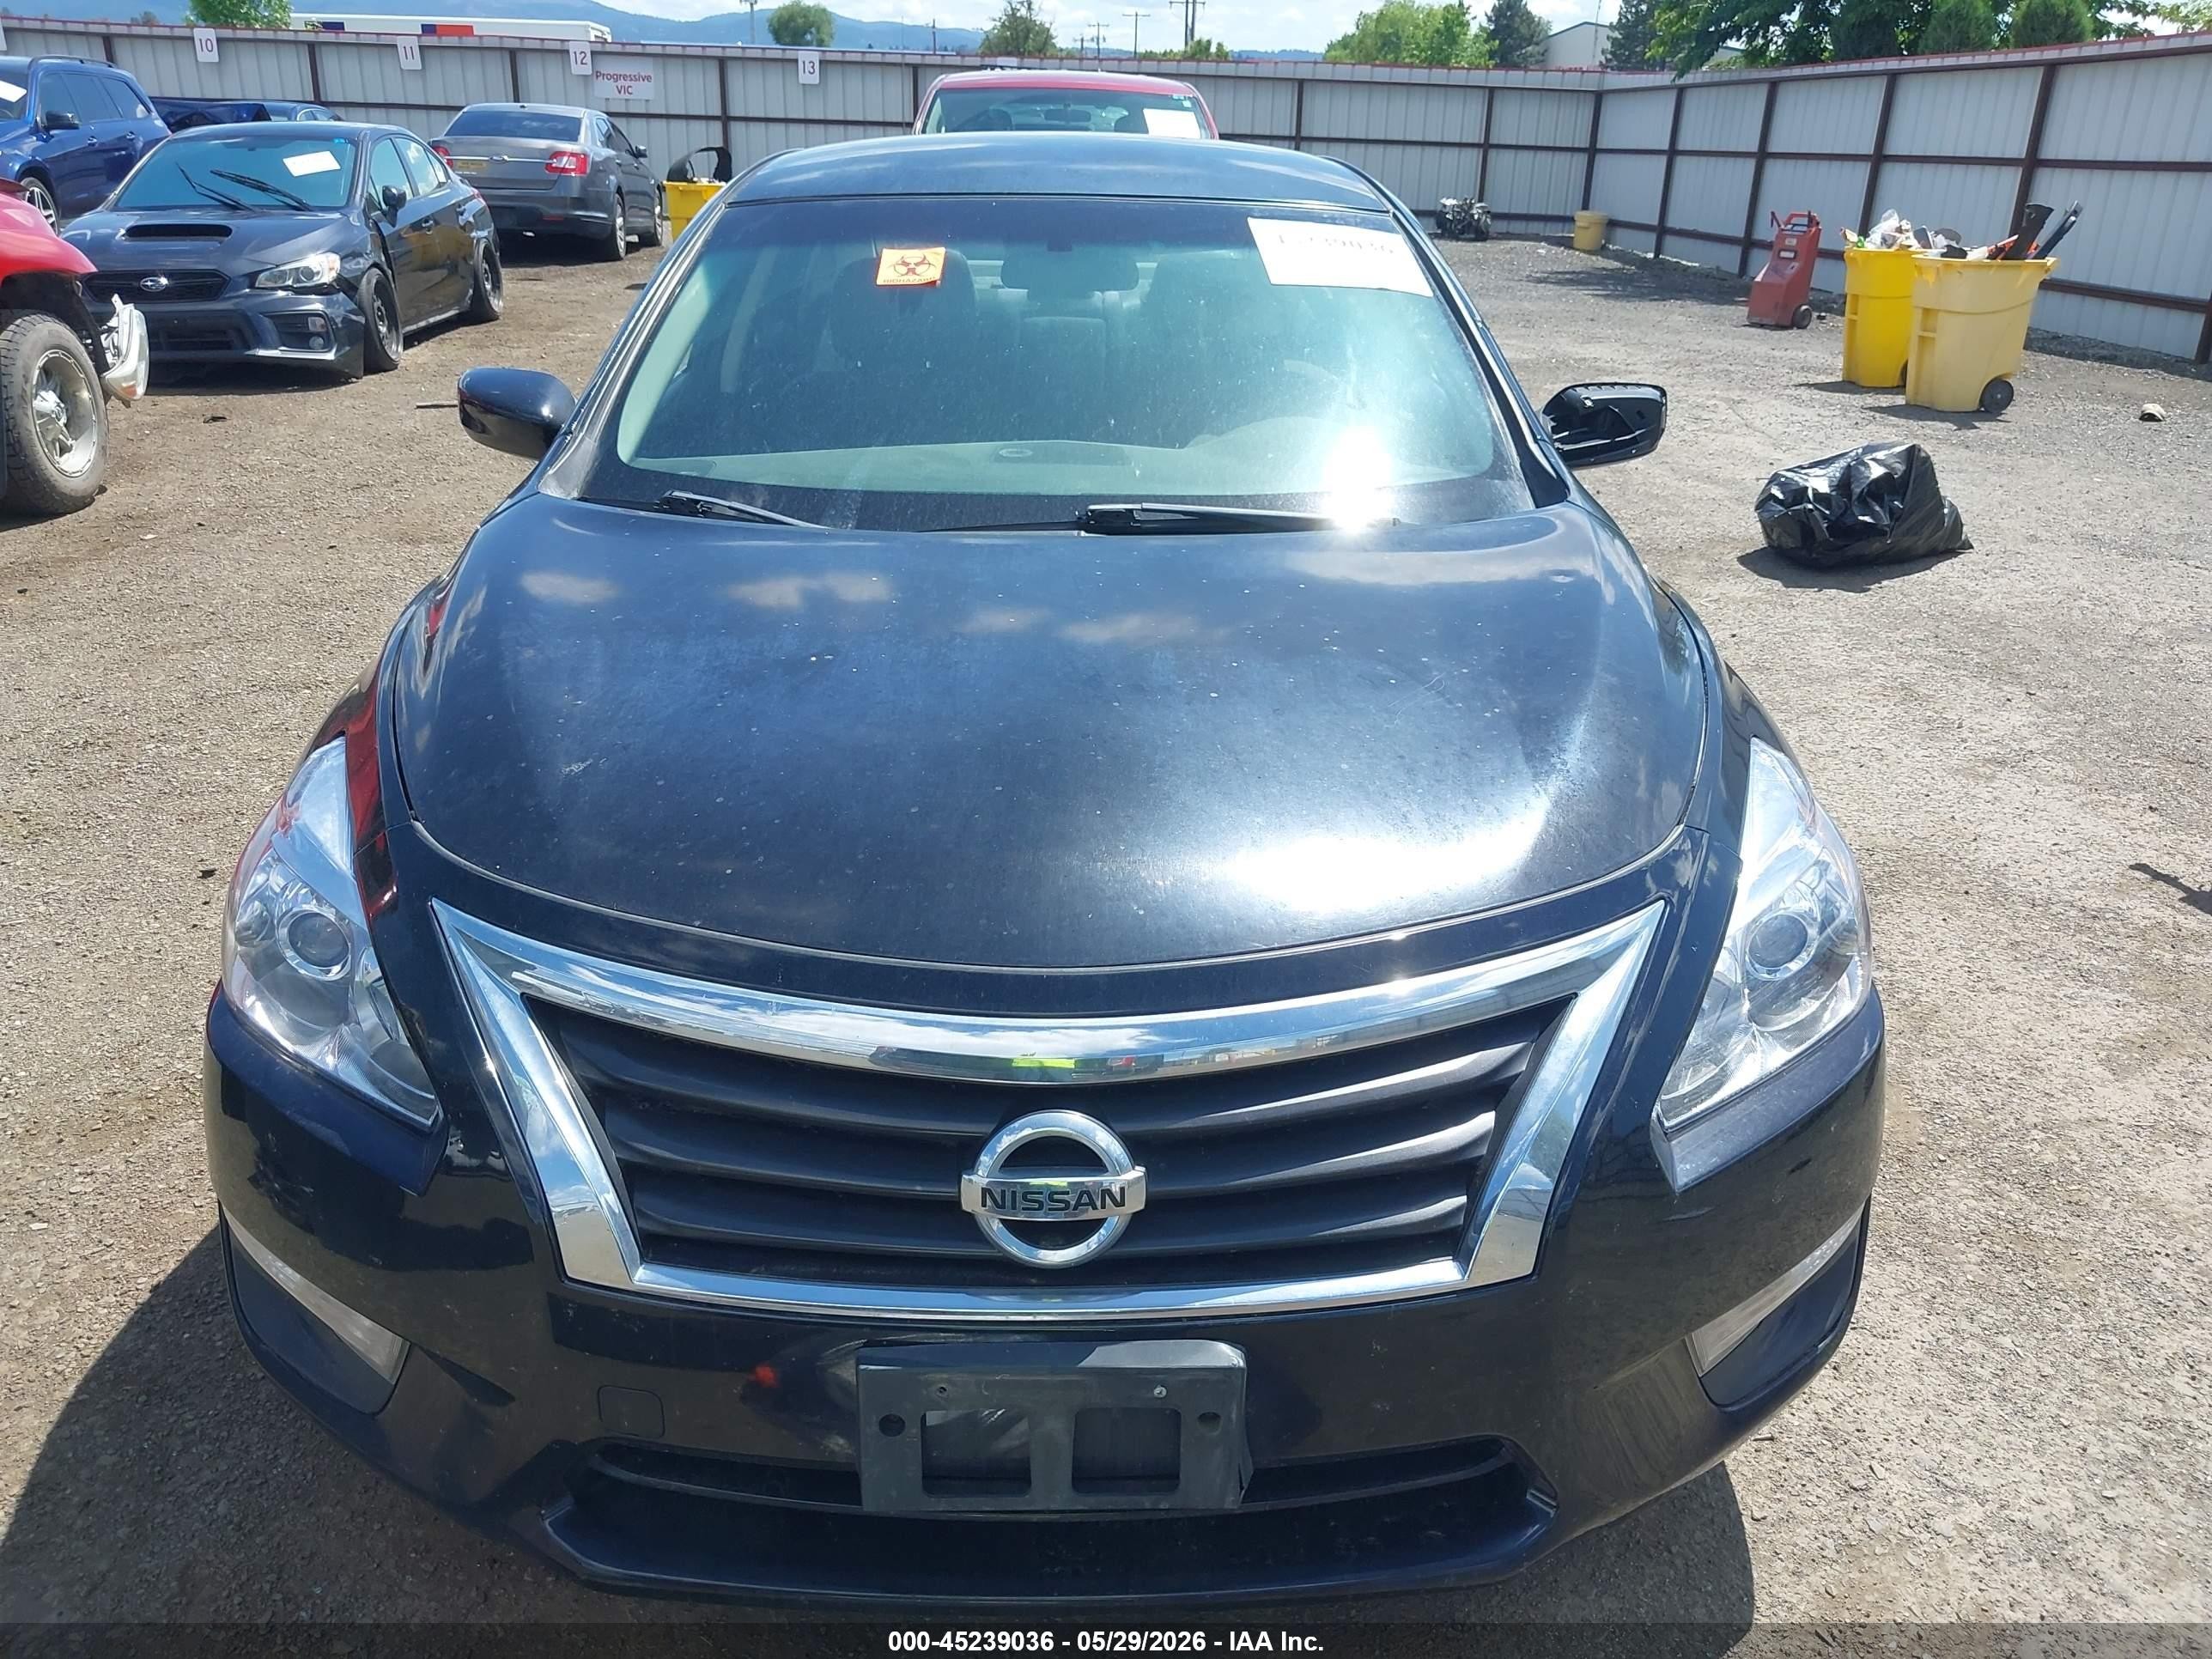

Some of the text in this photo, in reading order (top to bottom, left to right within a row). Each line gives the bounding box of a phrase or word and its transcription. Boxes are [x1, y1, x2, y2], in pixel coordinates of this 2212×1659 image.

[198, 38, 214, 52] 10
[403, 46, 415, 60] 11
[574, 51, 588, 65] 12
[802, 60, 816, 75] 13
[595, 70, 653, 83] Progressive
[616, 85, 634, 95] VIC
[981, 1187, 1126, 1212] NISSAN
